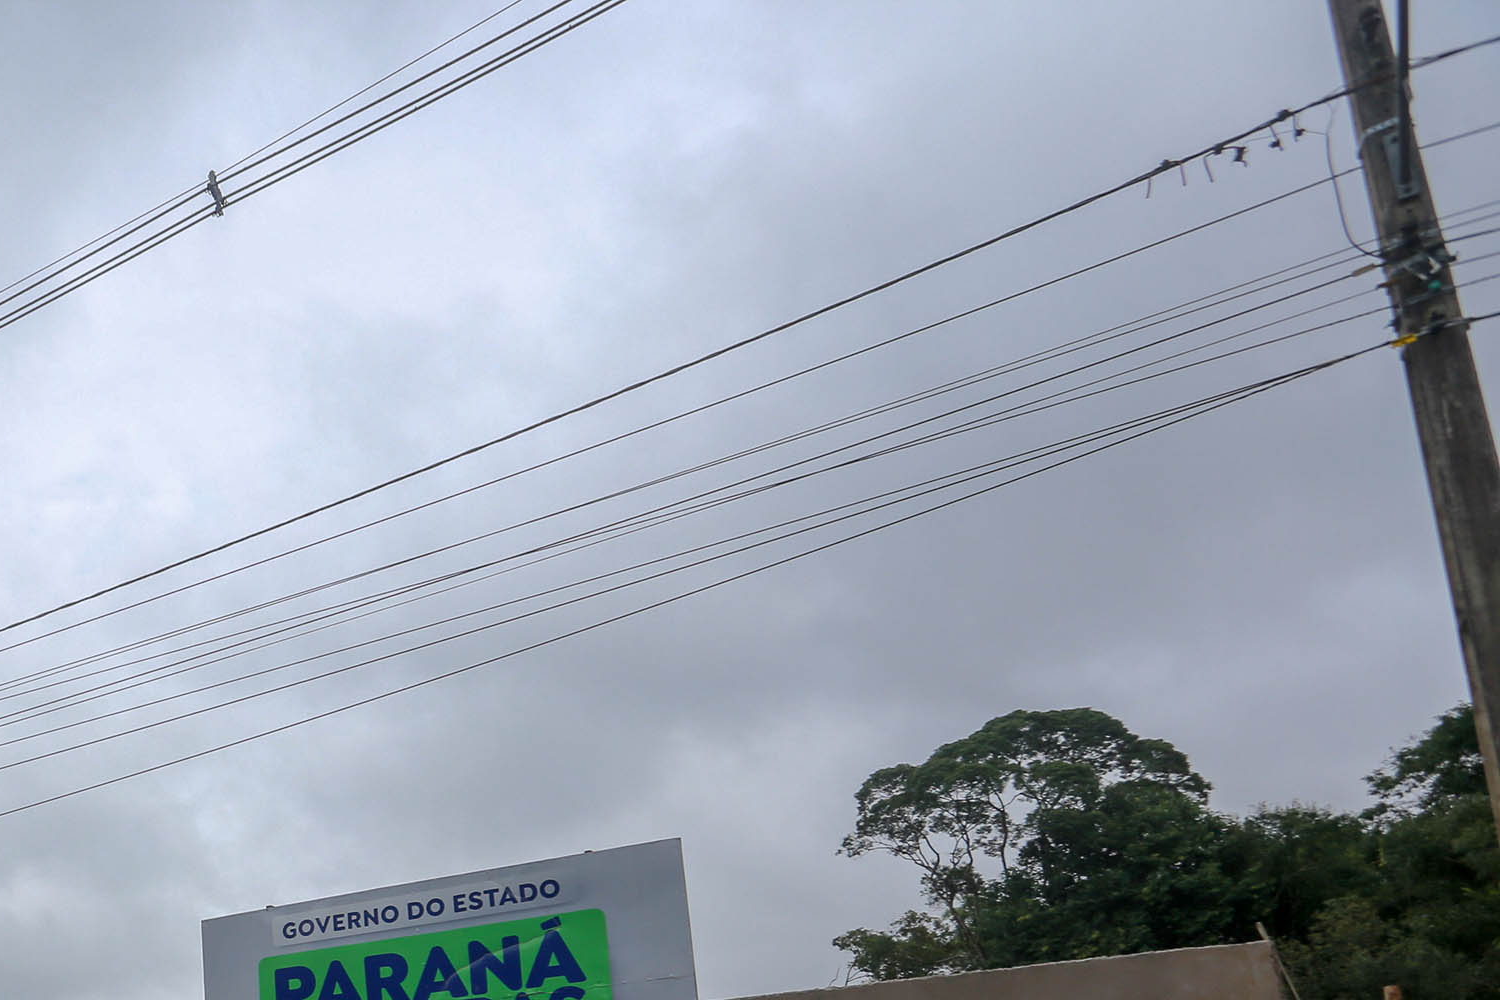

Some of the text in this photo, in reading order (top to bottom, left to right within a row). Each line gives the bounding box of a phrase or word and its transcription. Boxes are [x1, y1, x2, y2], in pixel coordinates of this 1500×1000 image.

[282, 879, 560, 939] GOVERNO DO ESTADO
